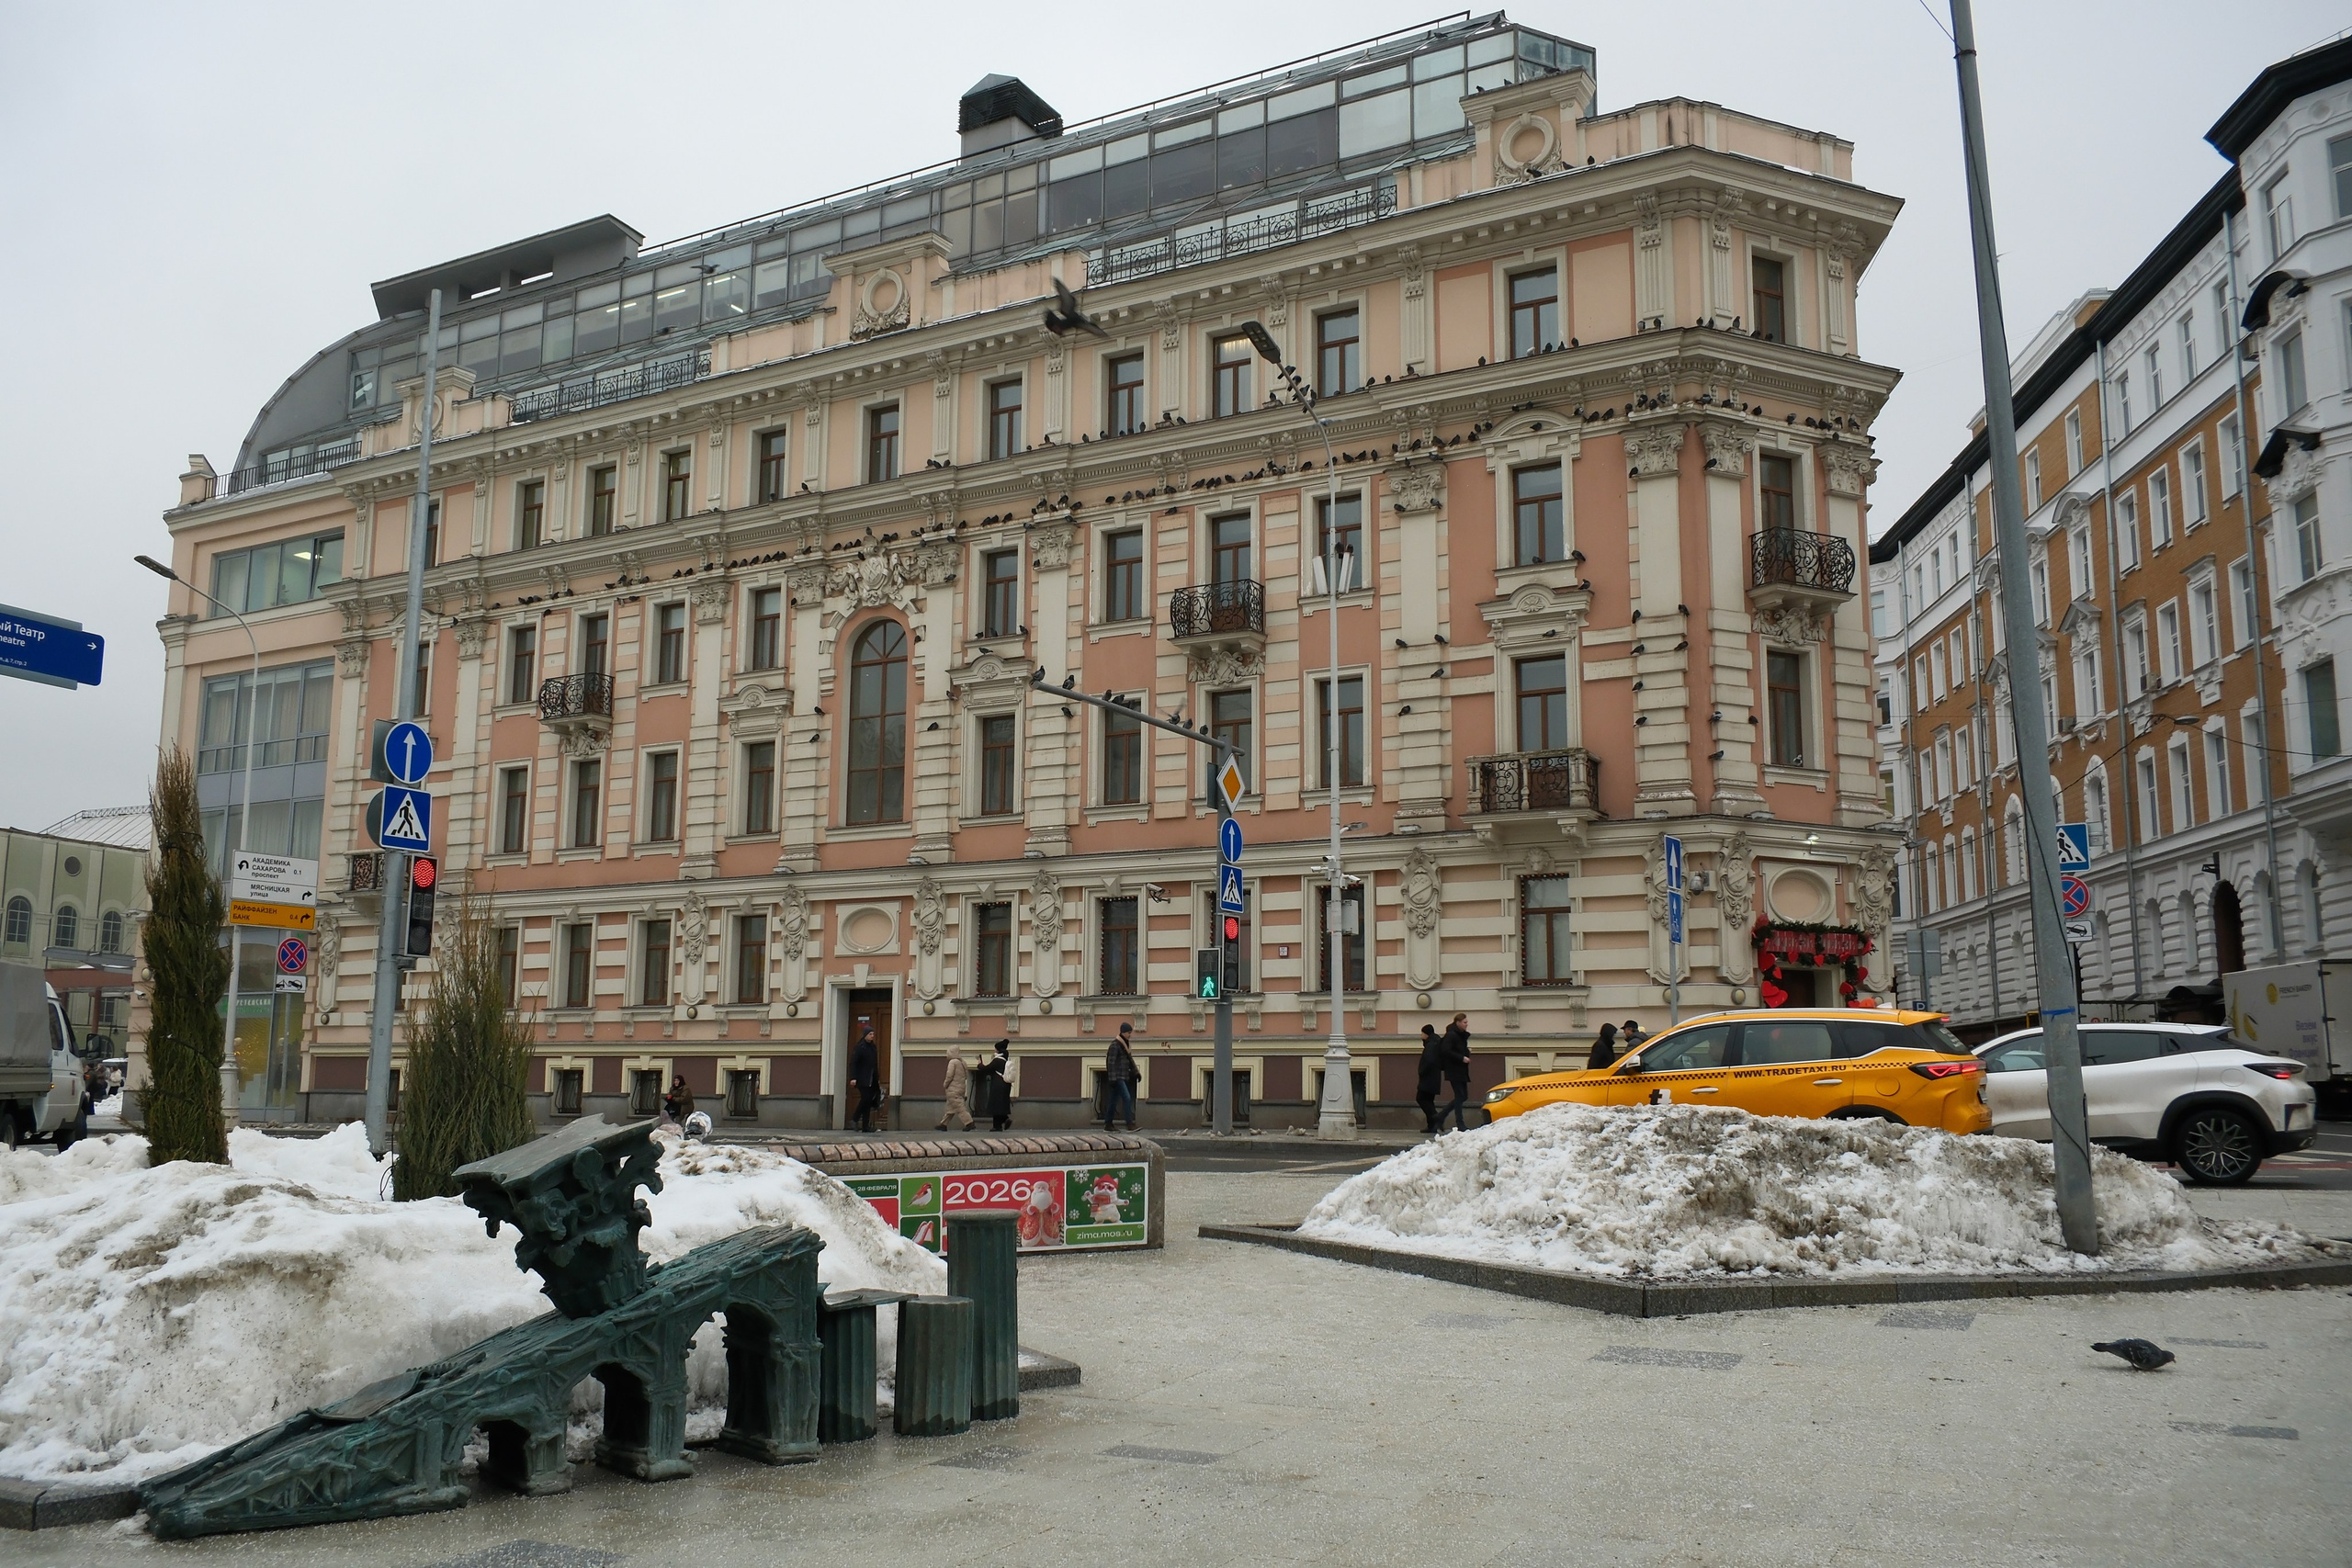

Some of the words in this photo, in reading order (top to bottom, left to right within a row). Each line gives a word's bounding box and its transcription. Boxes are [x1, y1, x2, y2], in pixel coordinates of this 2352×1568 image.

[14, 623, 45, 642] Театр
[252, 857, 291, 866] АКАДЕМИКА
[252, 864, 287, 874] САХАРОВА
[250, 884, 290, 893] МЯСНИЦКАЯ
[233, 904, 277, 914] РАЙФФАЙЗЕН
[1733, 1065, 1847, 1078] WWW.TRADETAXI.RU
[945, 1179, 1031, 1205] 2026
[1076, 1230, 1133, 1240] zima.mos.ru
